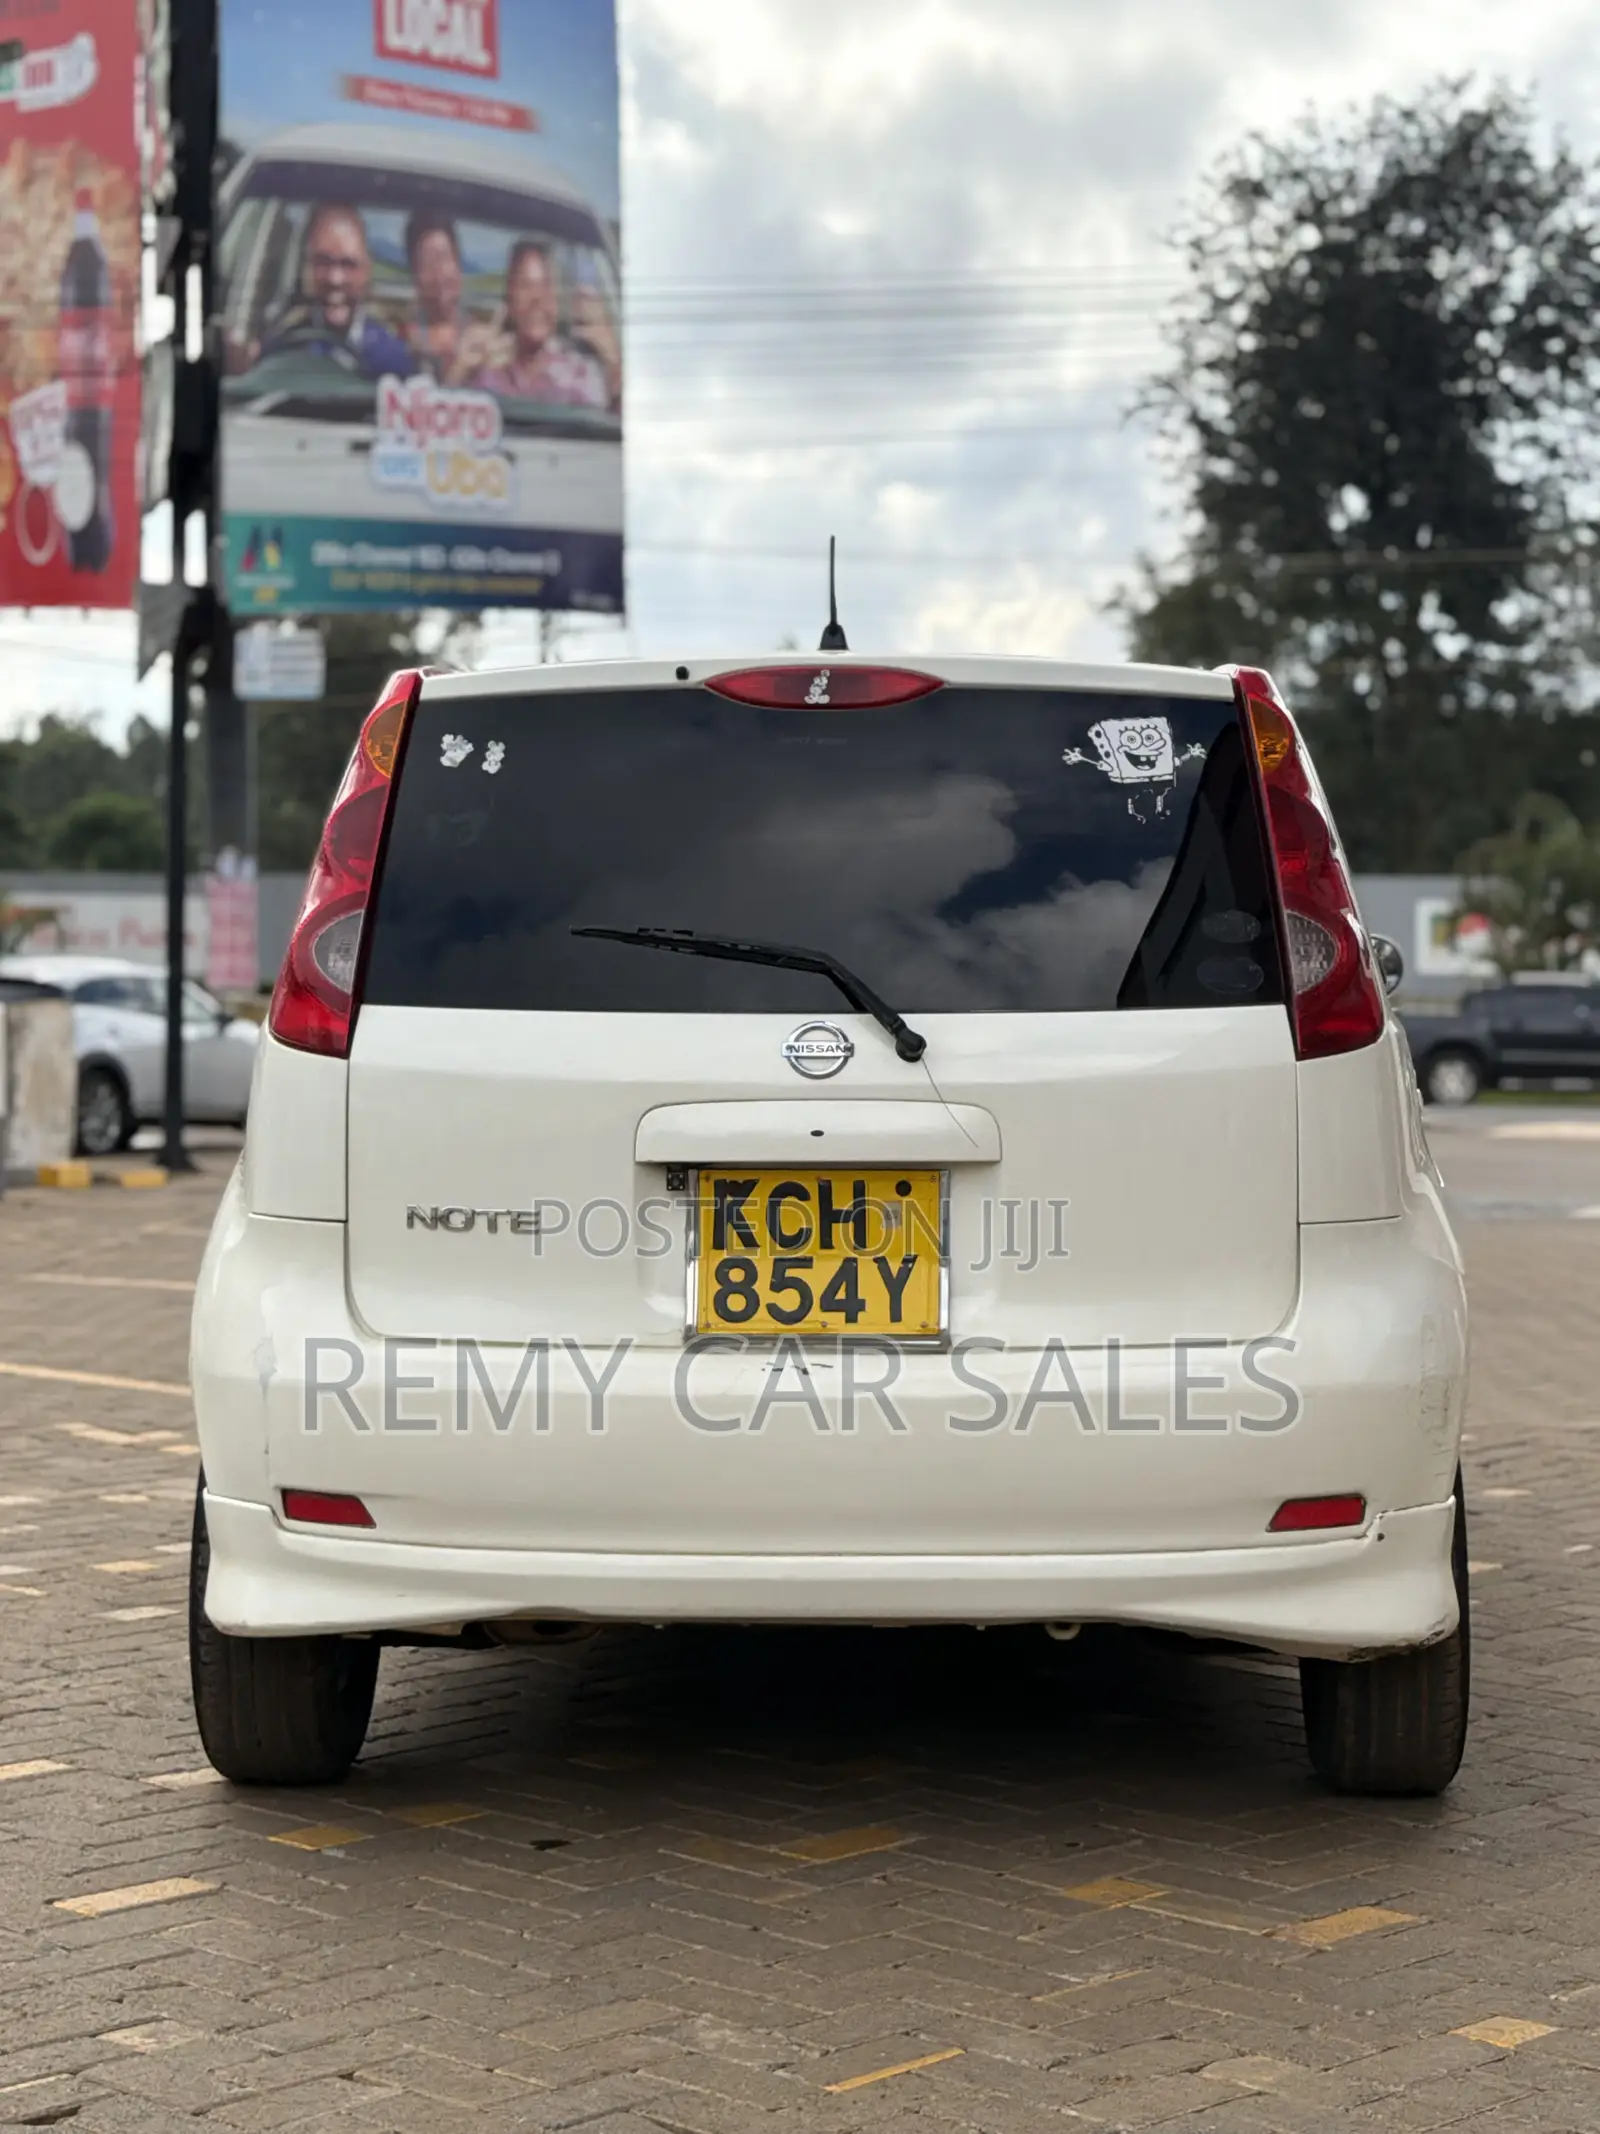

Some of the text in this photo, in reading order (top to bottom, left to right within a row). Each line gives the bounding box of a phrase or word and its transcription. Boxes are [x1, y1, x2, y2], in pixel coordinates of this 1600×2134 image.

[385, 388, 494, 449] Njoro
[787, 1044, 848, 1054] NISSAN
[406, 1204, 541, 1234] NOTE
[713, 1178, 867, 1251] KCH
[713, 1255, 918, 1326] 854Y
